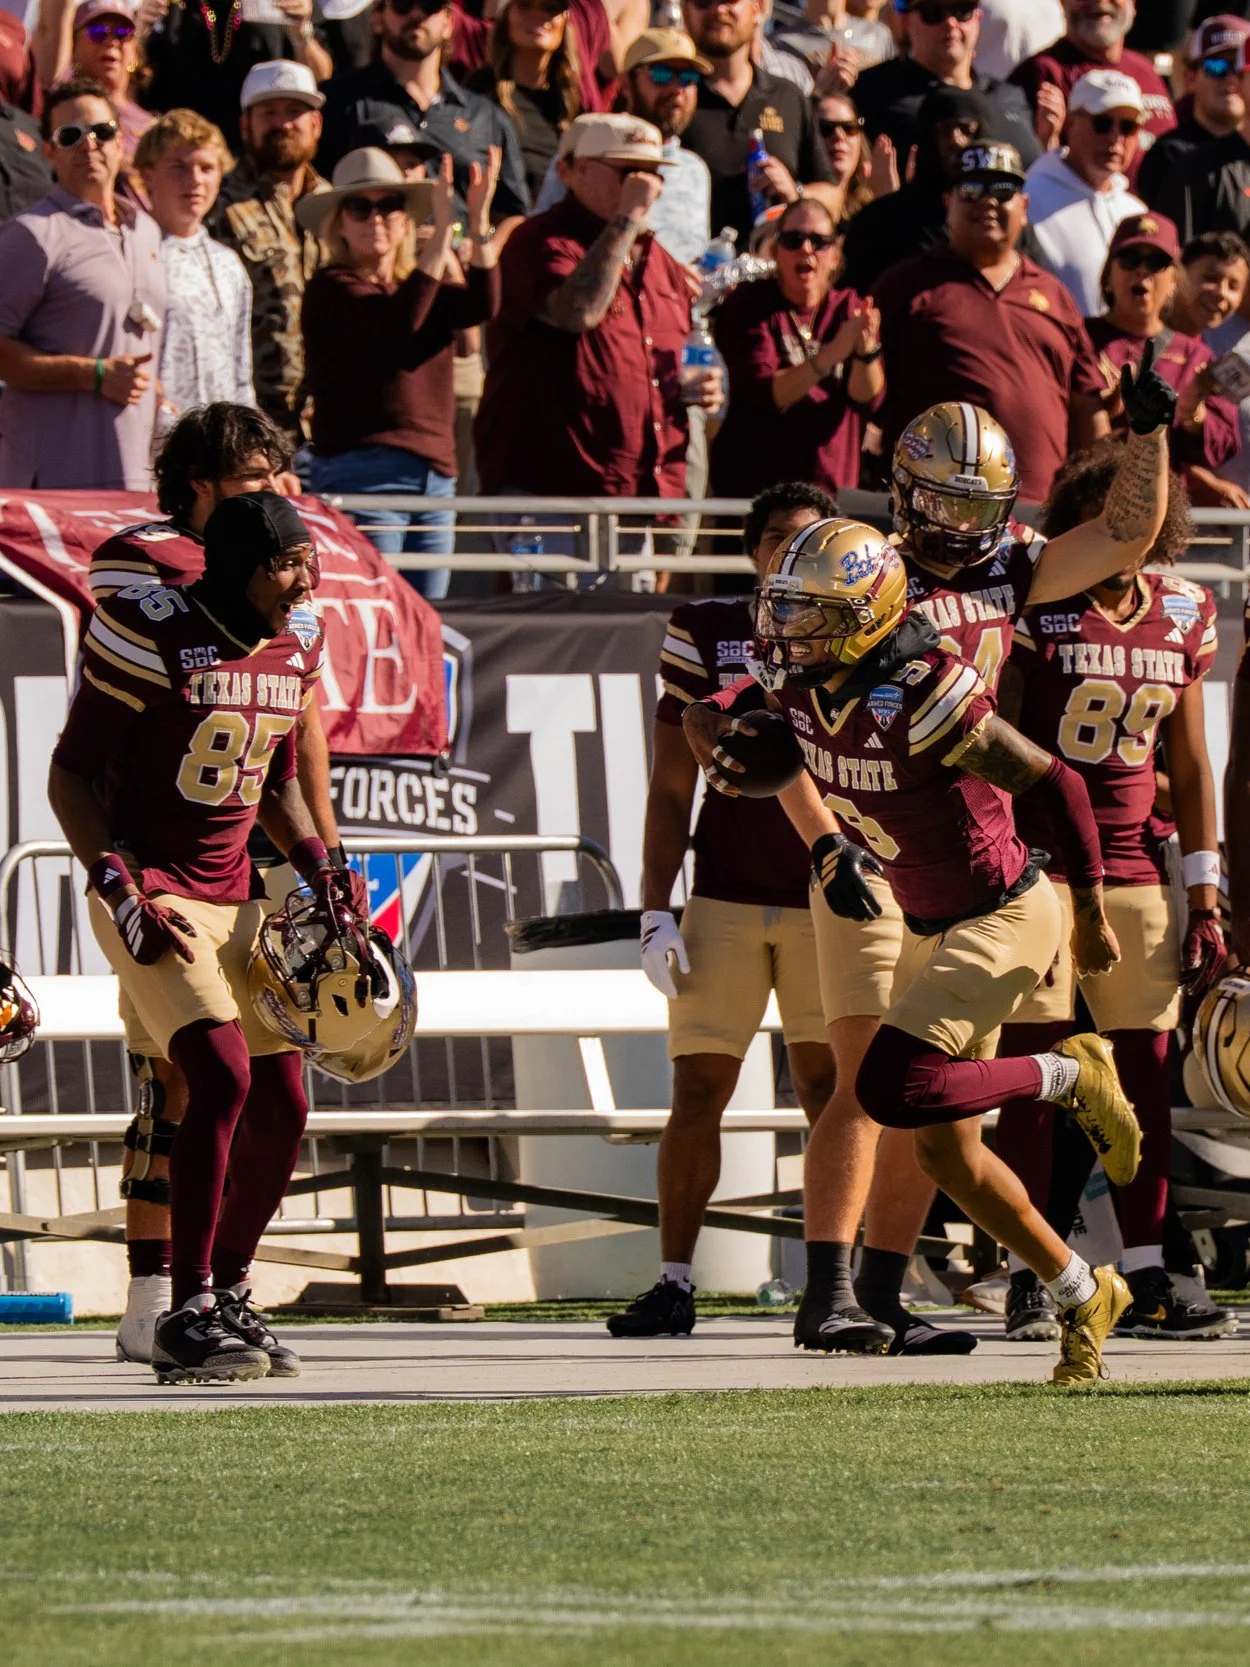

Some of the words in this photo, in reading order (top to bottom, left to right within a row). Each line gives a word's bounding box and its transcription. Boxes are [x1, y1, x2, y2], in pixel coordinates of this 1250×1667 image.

[962, 146, 1014, 172] SWT
[954, 476, 983, 485] BOBCATS
[963, 584, 1016, 624] STATE
[1040, 612, 1082, 633] SBC
[180, 645, 222, 670] SBC
[717, 640, 755, 657] SBC
[1058, 643, 1126, 677] TEXAS
[1131, 647, 1185, 685] STATE
[188, 671, 252, 706] TEXAS
[256, 673, 304, 711] STATE
[789, 707, 814, 736] SBC
[1056, 678, 1177, 768] 89
[175, 710, 297, 807] 85
[837, 755, 900, 793] STATE
